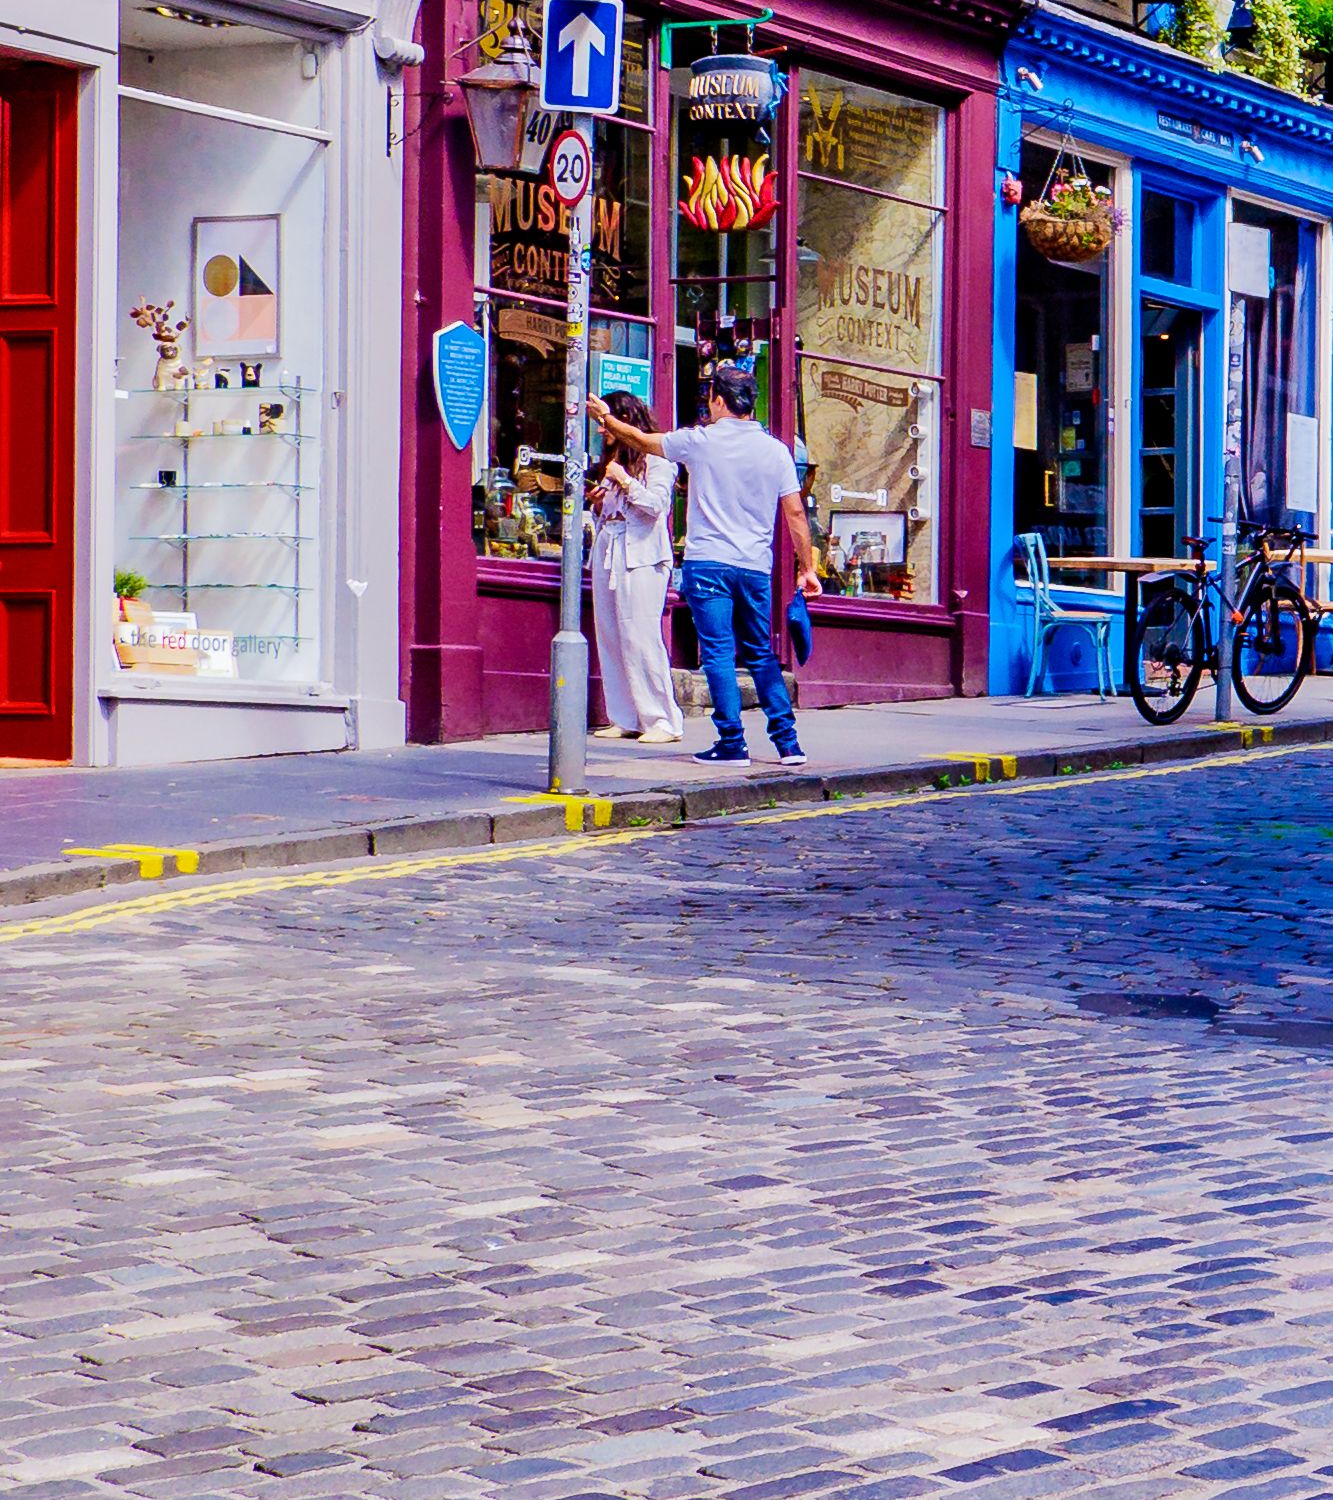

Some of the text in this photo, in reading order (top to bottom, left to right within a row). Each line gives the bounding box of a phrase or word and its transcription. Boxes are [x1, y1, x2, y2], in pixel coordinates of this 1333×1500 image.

[689, 74, 759, 99] MUSEUM
[525, 109, 552, 146] 40
[689, 102, 758, 121] CONTEXT
[556, 153, 584, 184] 20
[817, 257, 921, 331] MUSEUM
[836, 315, 902, 351] CONTEXT
[130, 626, 281, 660] the red door gallery
